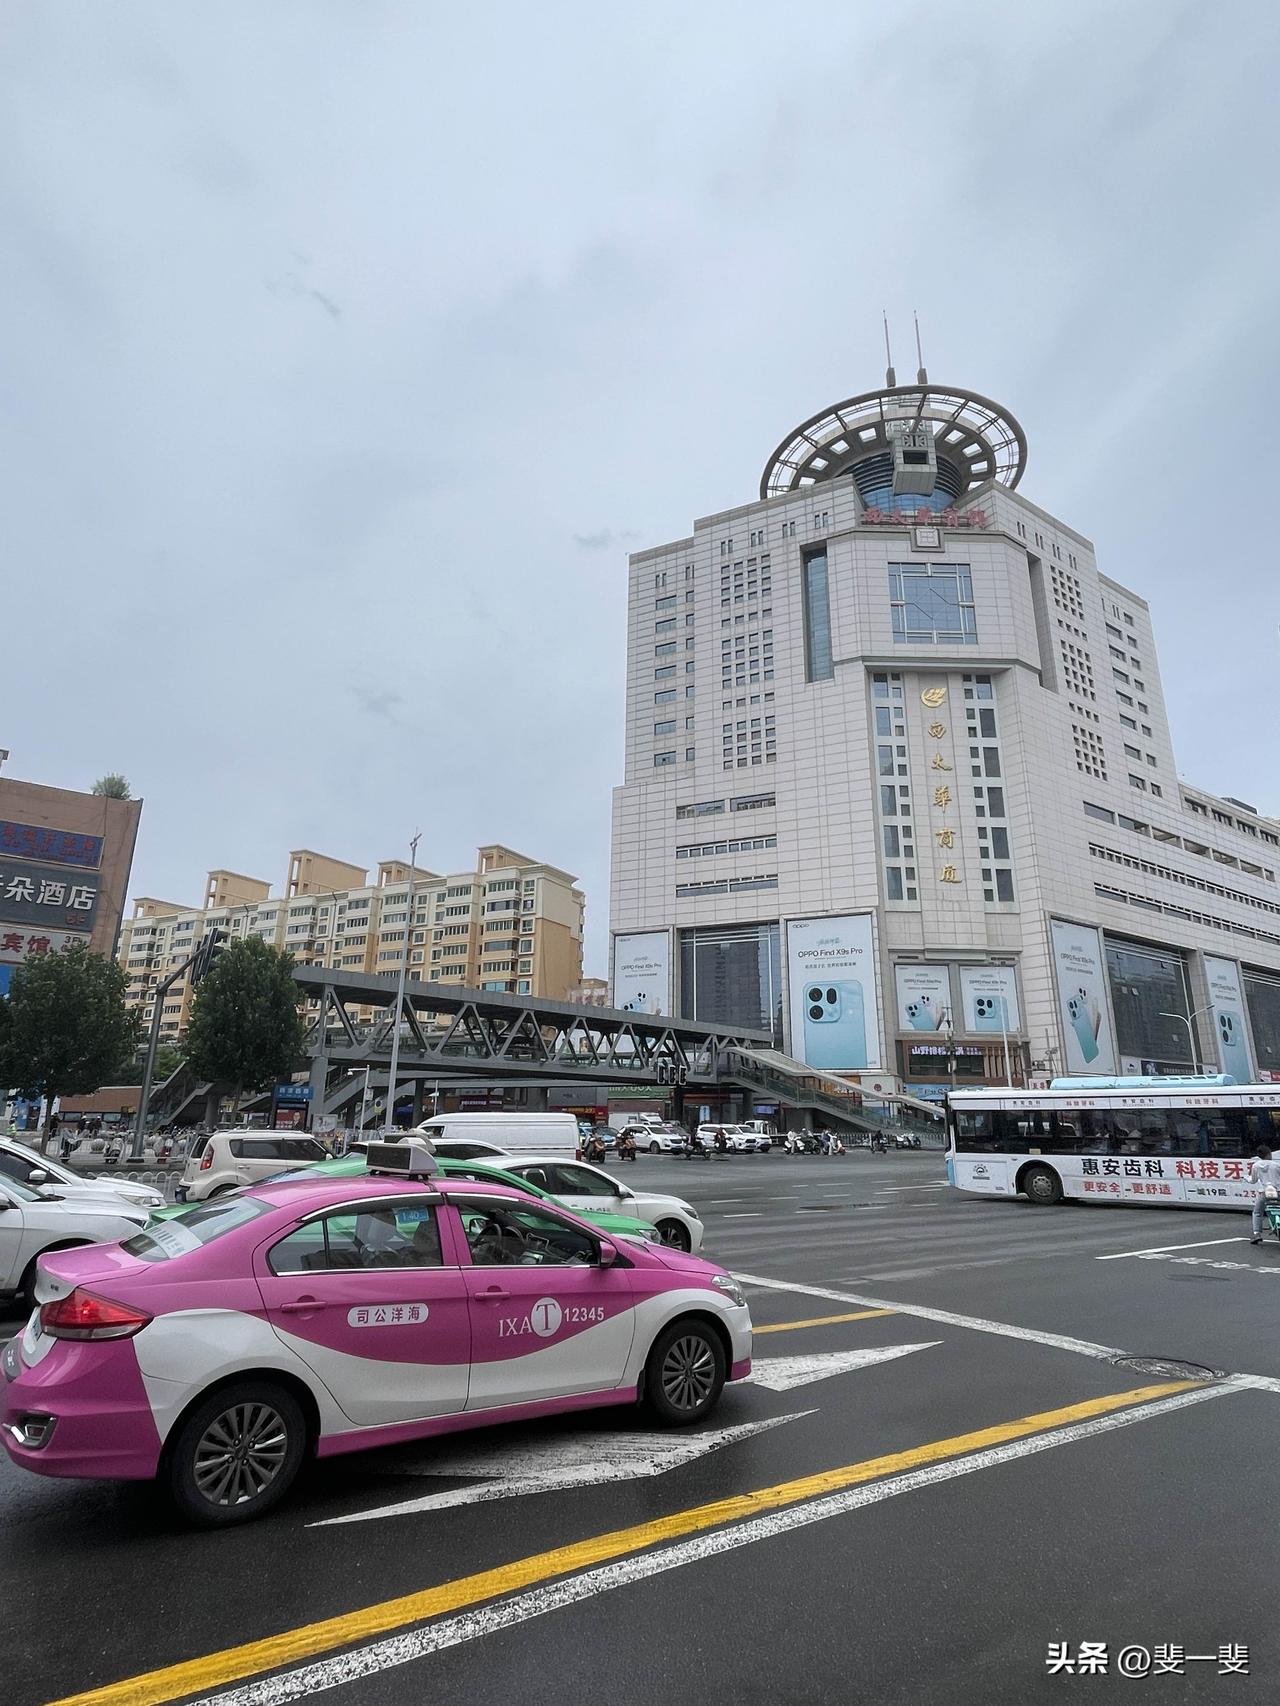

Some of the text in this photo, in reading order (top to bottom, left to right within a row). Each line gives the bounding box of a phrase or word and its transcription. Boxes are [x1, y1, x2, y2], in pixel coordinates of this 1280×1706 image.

[0, 875, 97, 911] 朵酒店
[797, 949, 819, 958] OPPO
[820, 949, 835, 957] Find
[836, 947, 850, 956] X9s
[850, 946, 863, 955] Pro
[1081, 1158, 1164, 1178] 惠安齿科
[1084, 1181, 1121, 1193] 更安全
[563, 1306, 605, 1322] 12345
